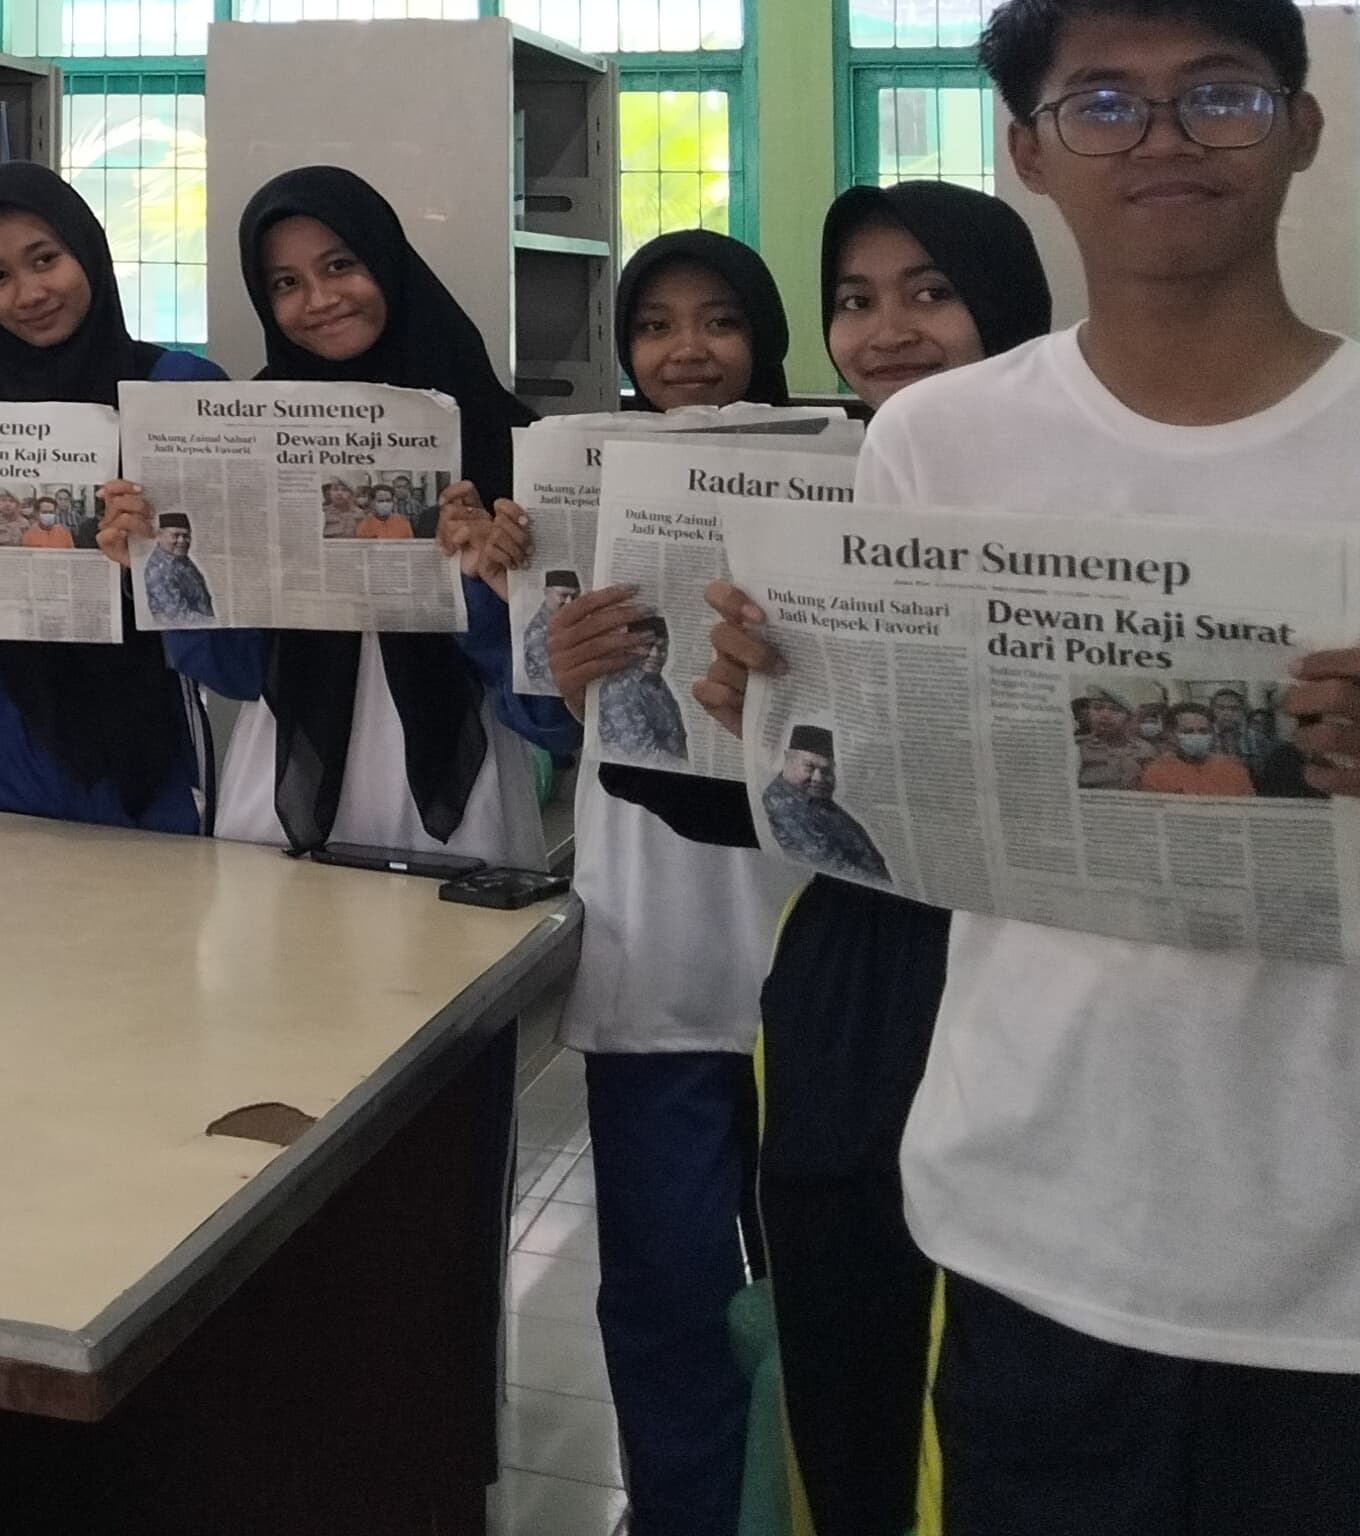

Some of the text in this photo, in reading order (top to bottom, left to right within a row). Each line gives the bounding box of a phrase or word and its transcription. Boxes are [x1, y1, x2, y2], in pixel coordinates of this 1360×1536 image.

[196, 399, 385, 423] Radar Sumenep
[276, 432, 438, 450] Dewan Kaji Surat
[13, 448, 48, 464] Kaji
[51, 449, 97, 463] Surat
[276, 449, 376, 465] dari Polres
[688, 467, 854, 504] Radar Sum
[625, 508, 717, 527] Dukung Zainul
[631, 523, 655, 535] Jadi
[658, 524, 704, 541] Kepsek
[842, 534, 969, 571] Radar
[982, 541, 1191, 595] Sumenep
[767, 587, 949, 617] Dukung Zainul Sahari
[779, 608, 940, 636] Jadi Kepsek Favorit
[987, 599, 1296, 646] Dewan Kaji Surat
[987, 632, 1174, 669] dari Polres
